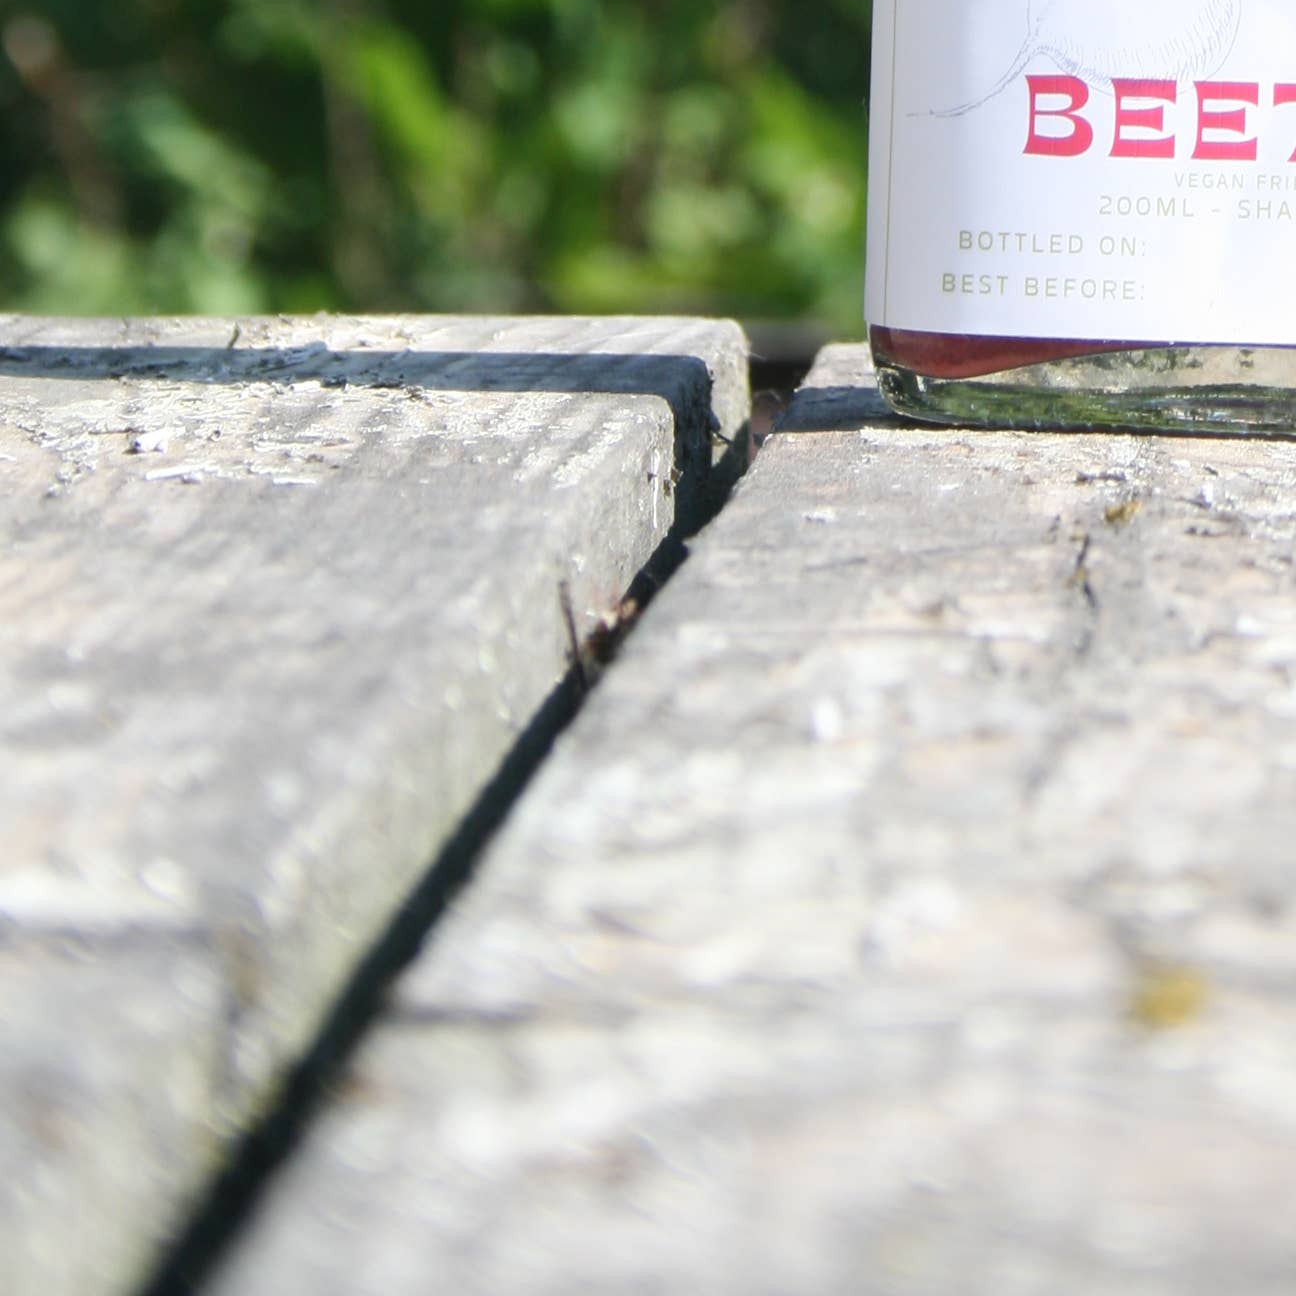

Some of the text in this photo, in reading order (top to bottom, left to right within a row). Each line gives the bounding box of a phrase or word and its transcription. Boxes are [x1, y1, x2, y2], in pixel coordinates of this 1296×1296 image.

[1174, 172, 1244, 189] VEGAN
[1099, 196, 1194, 217] 200ML
[959, 230, 1083, 254] BOTTLED
[942, 273, 1009, 296] BEST
